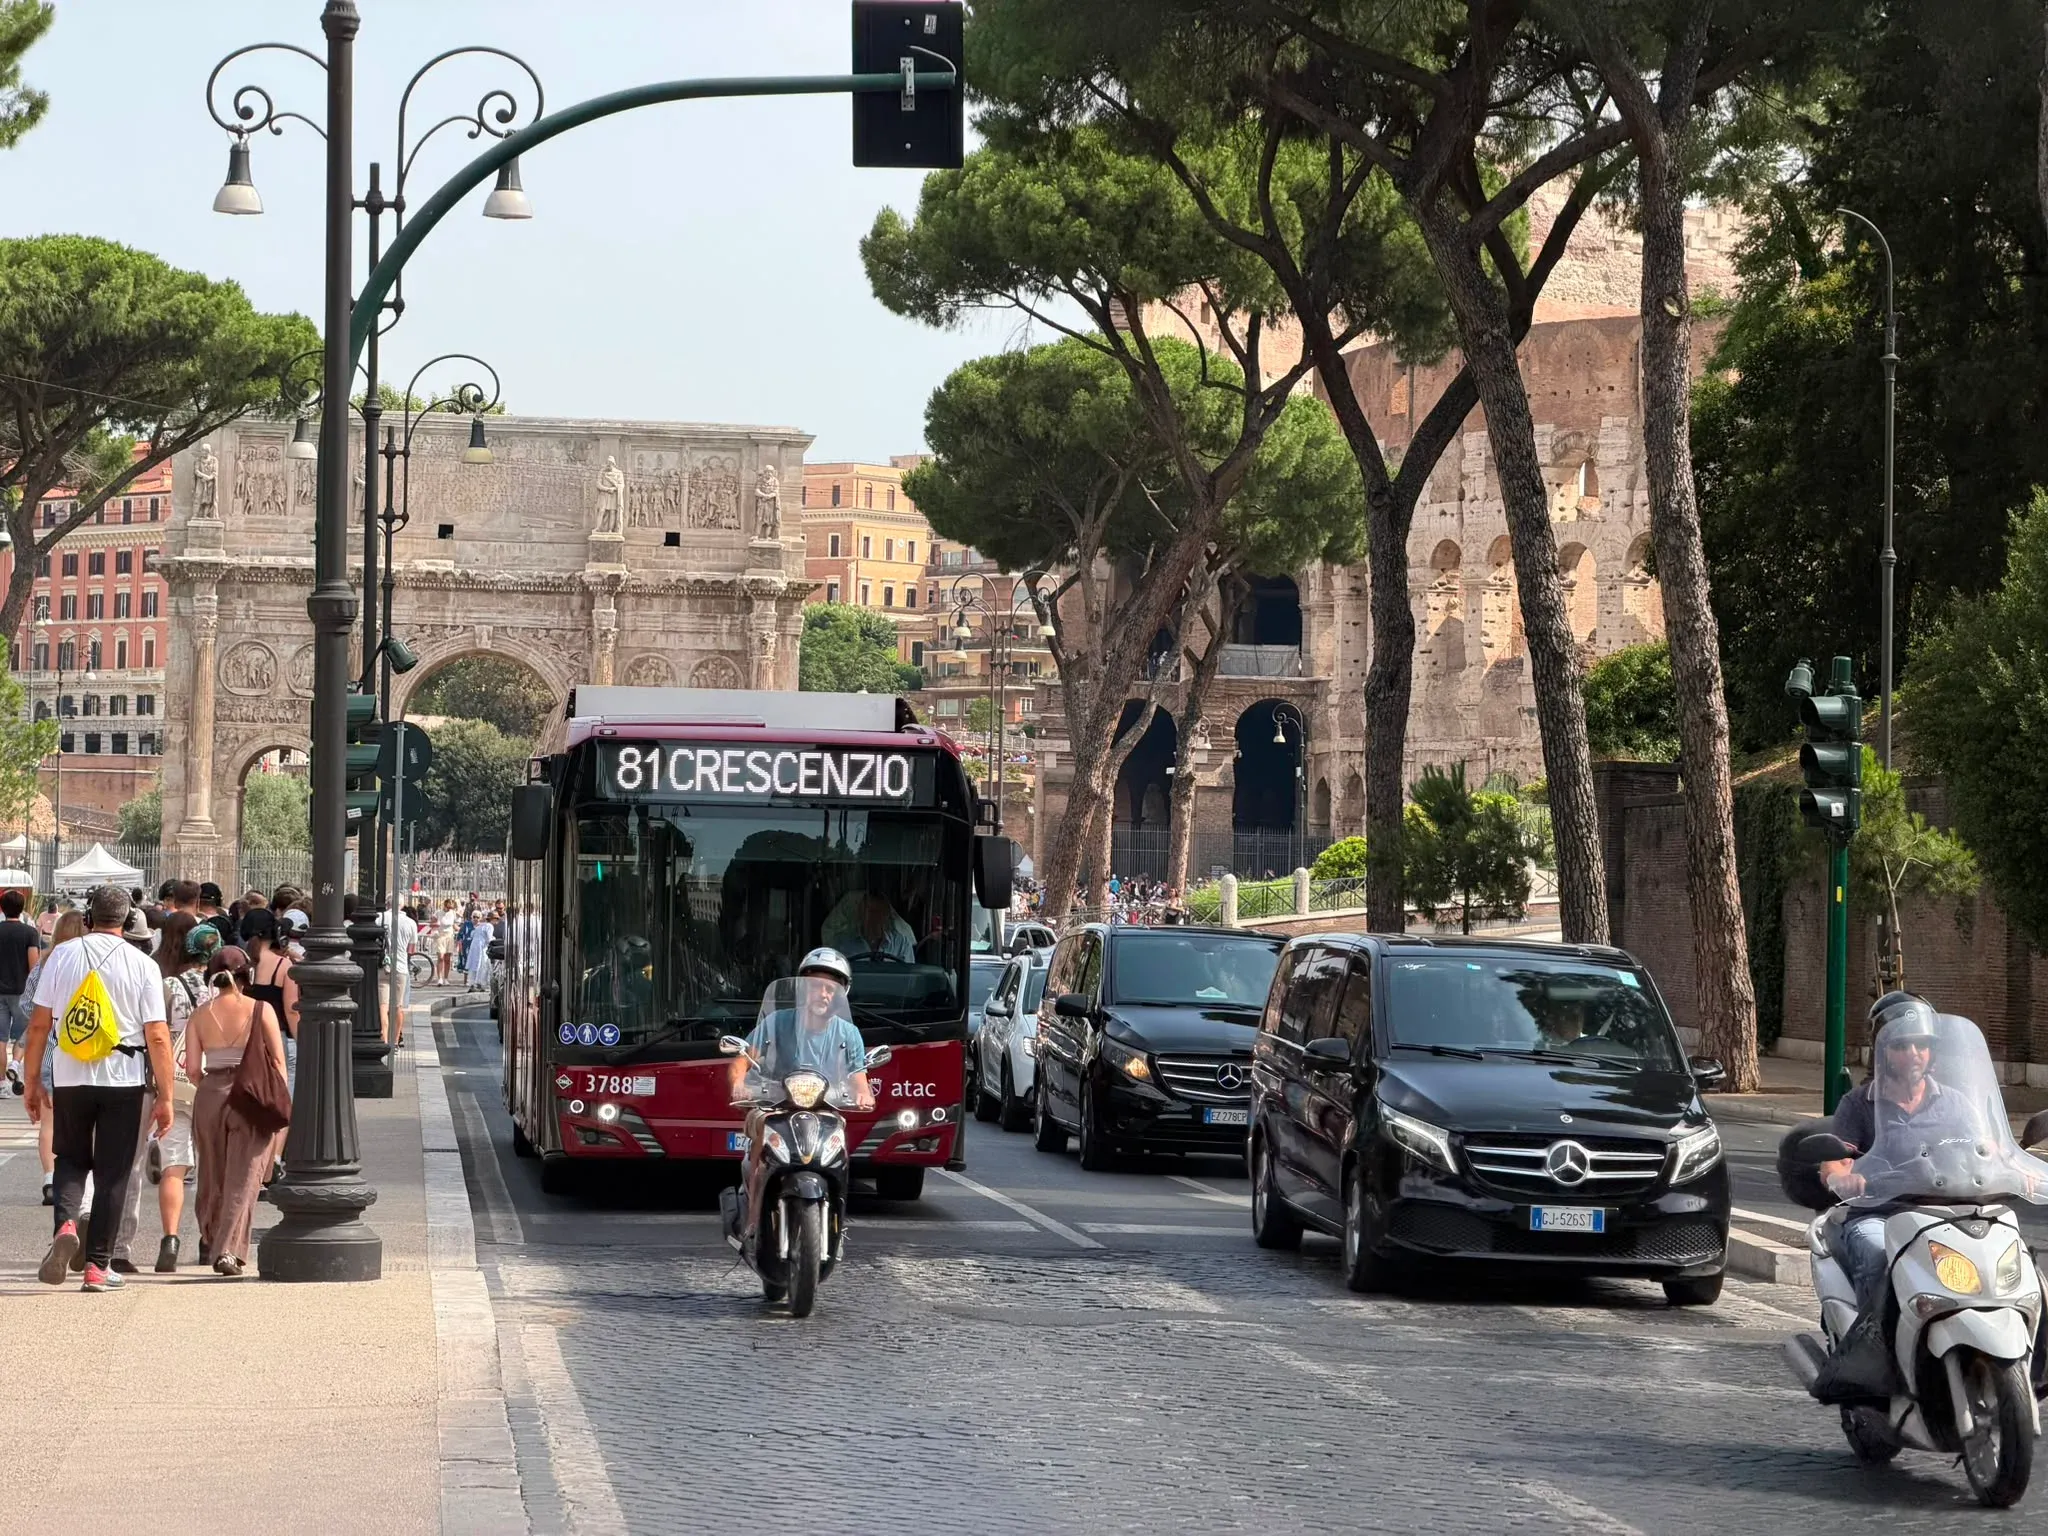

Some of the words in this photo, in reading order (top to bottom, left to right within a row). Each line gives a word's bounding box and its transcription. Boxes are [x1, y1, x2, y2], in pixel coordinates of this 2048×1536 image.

[617, 747, 660, 790] 81
[669, 748, 909, 797] CRESCENZIO
[69, 1007, 95, 1031] 105
[585, 1074, 632, 1094] 3788
[891, 1080, 936, 1097] atac
